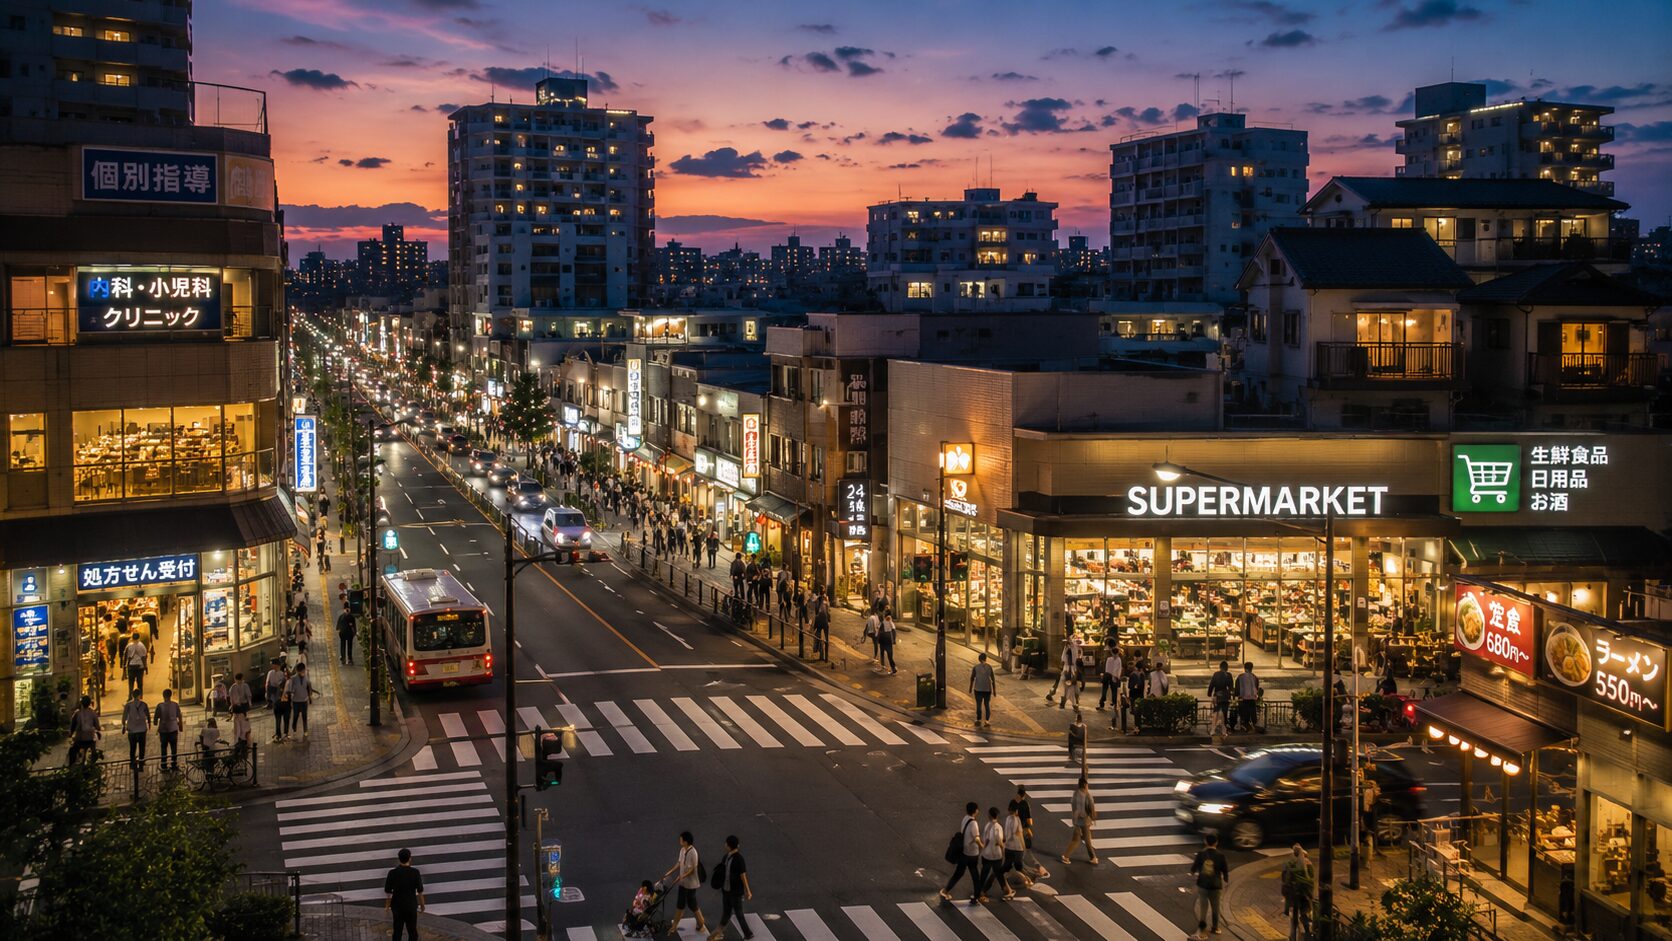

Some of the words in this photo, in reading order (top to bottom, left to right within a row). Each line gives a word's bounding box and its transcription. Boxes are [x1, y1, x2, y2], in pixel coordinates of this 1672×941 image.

[91, 160, 211, 194] 個別指導
[88, 276, 212, 299] 内科・小児科
[103, 306, 200, 328] クリニック
[1530, 445, 1609, 465] 生鮮食品
[1531, 469, 1589, 489] 日用品
[1127, 485, 1389, 516] SUPERMARKET
[1530, 492, 1569, 512] お酒
[83, 558, 195, 587] 処方せん受付
[1596, 638, 1659, 681] ラーメン
